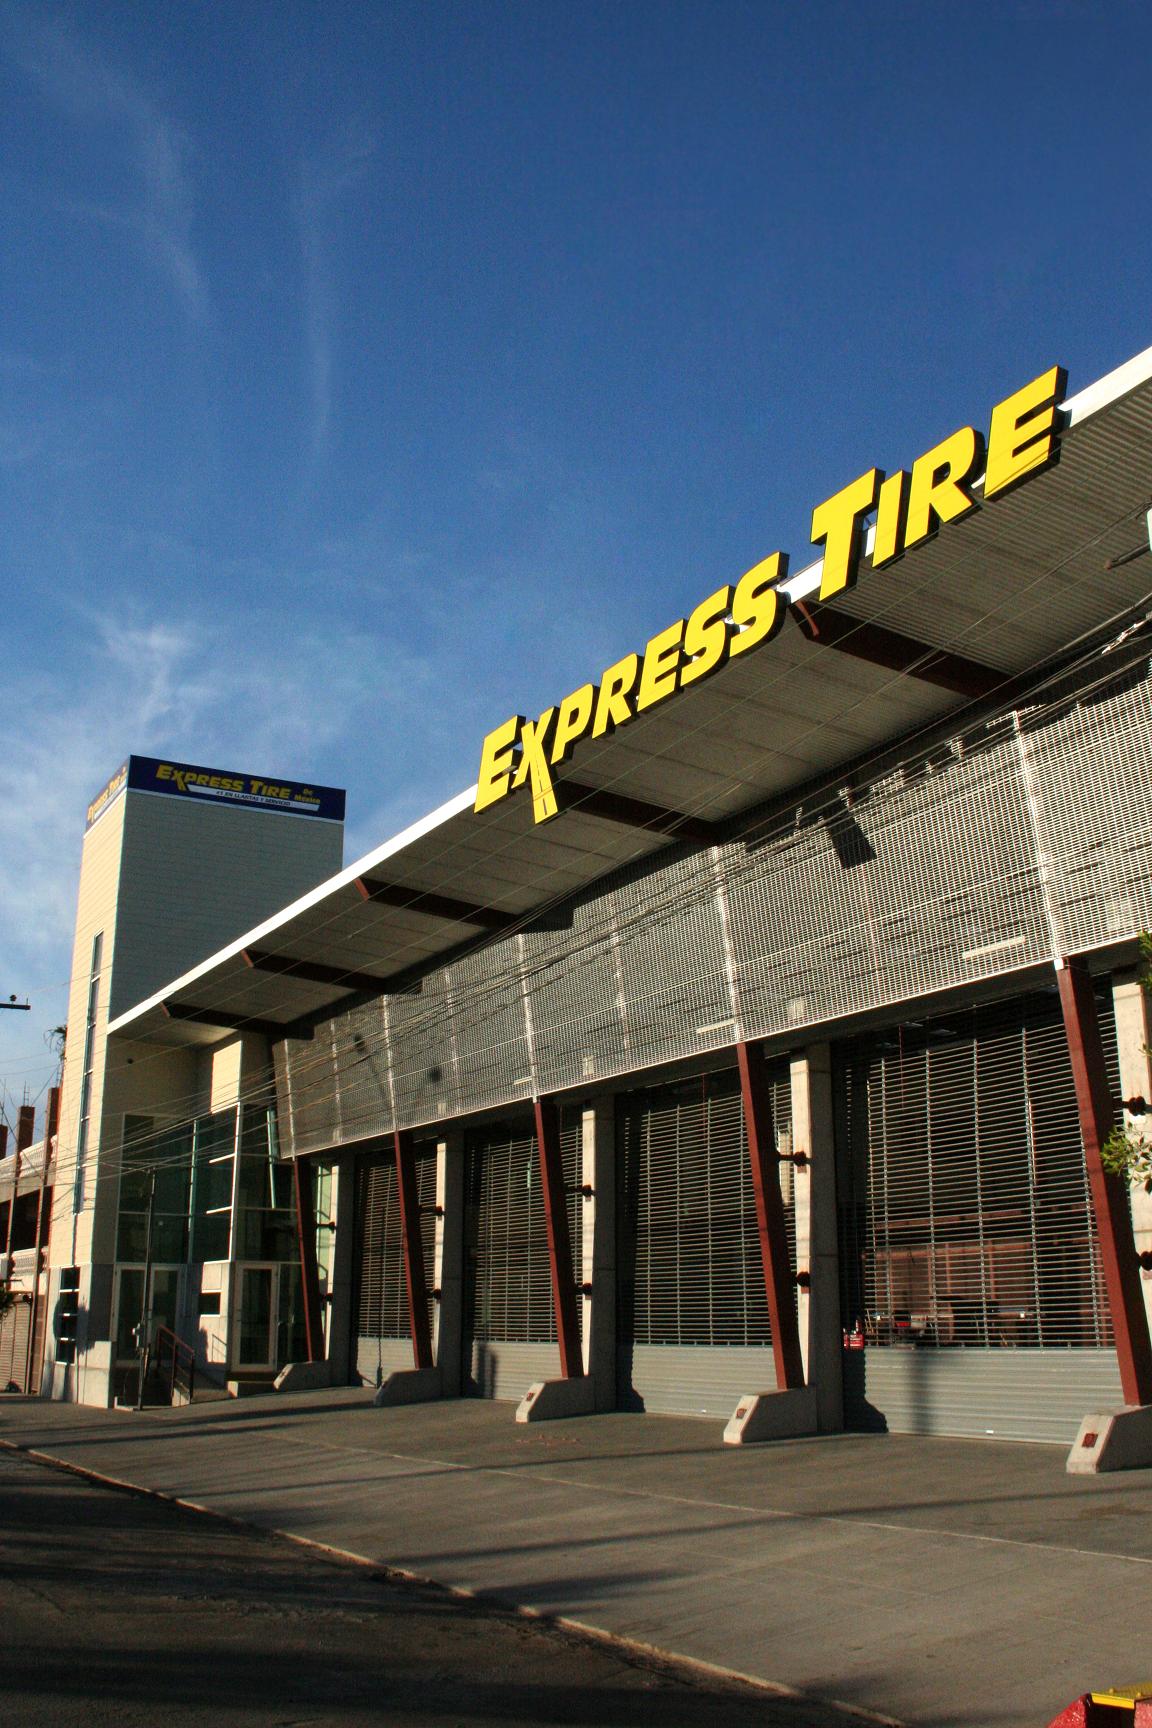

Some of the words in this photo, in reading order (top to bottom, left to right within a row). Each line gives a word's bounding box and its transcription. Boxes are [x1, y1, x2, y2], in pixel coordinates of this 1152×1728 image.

[474, 552, 787, 825] EXPRESS
[810, 365, 1066, 601] TIRE
[156, 764, 244, 791] EXPRESS
[250, 779, 291, 798] TIRE
